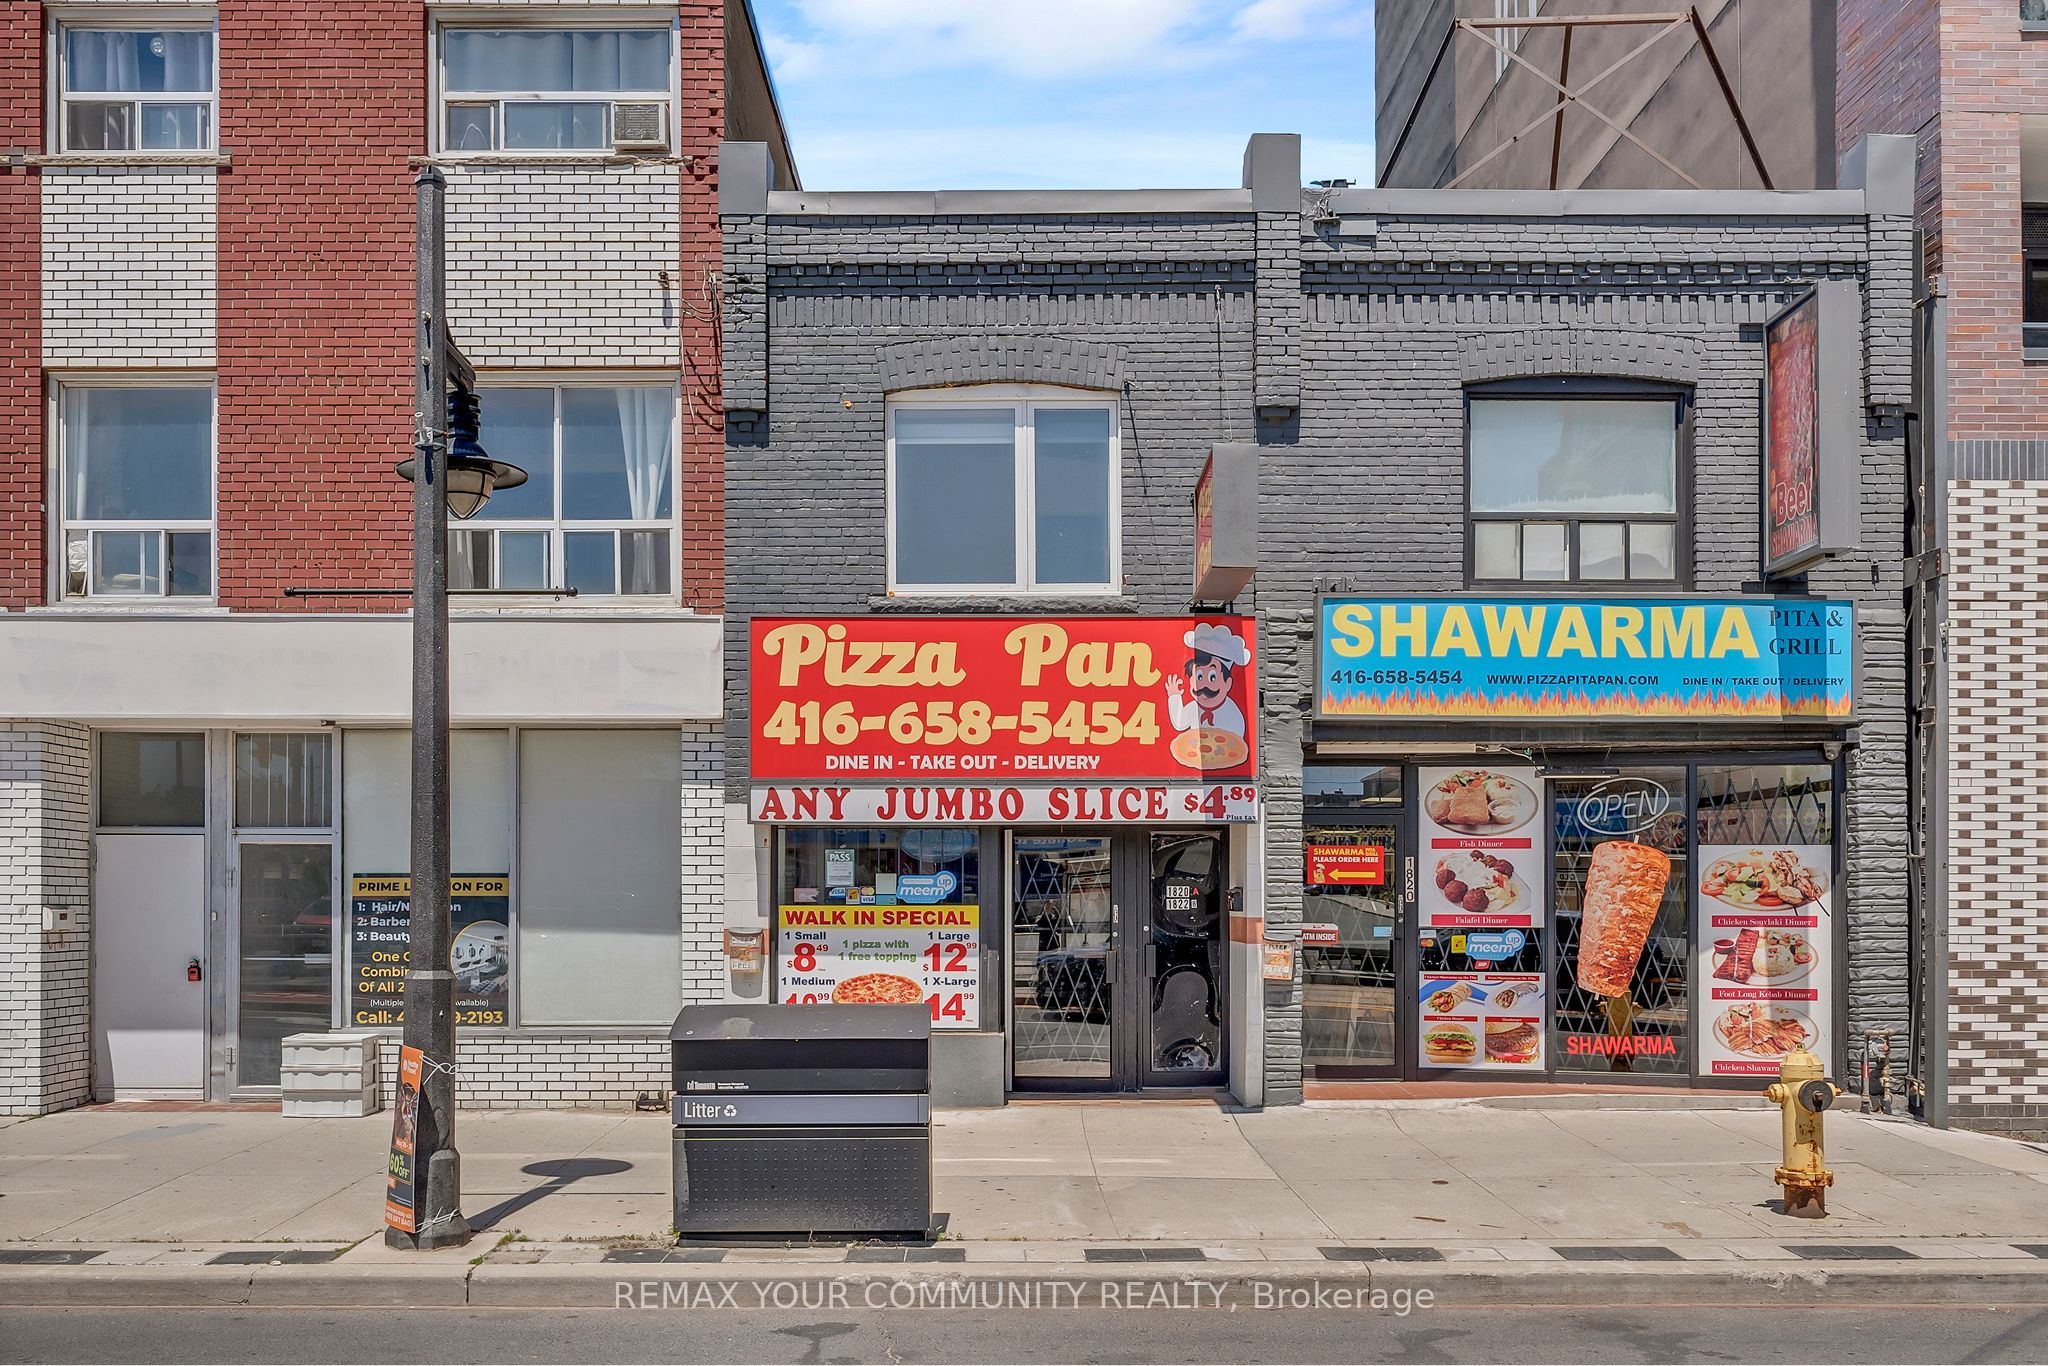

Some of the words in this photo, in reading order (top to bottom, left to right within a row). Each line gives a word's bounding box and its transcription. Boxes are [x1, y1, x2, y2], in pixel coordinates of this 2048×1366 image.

[1776, 466, 1812, 526] Beef
[1772, 513, 1818, 559] SHAWARMA
[1769, 610, 1820, 627] PITA
[1827, 610, 1843, 627] &
[1331, 604, 1760, 659] SHAWARMA
[1769, 638, 1842, 655] GRILL
[763, 624, 966, 687] Pizza
[1004, 624, 1161, 687] Pan
[1331, 670, 1462, 684] 416-658-5454
[1487, 675, 1659, 685] WWW.PIZZAPITAPAN.COM
[1683, 677, 1708, 685] DINE
[1712, 677, 1723, 685] IN
[1732, 677, 1759, 685] TAKE
[1762, 677, 1784, 685] OUT
[1793, 677, 1844, 686] DELIVERY
[763, 701, 1161, 745] 416-658-5454
[826, 755, 869, 770] DINE
[874, 755, 893, 770] IN
[910, 755, 956, 770] TAKE
[960, 755, 997, 770] OUT
[1014, 755, 1101, 770] DELIVERY
[759, 787, 851, 820] ANY
[877, 787, 1024, 820] JUMBO
[1048, 787, 1169, 820] SLICE
[1584, 788, 1660, 822] OPEN
[359, 882, 400, 892] PRIME
[476, 882, 503, 892] FOR
[900, 886, 945, 896] meem
[1168, 887, 1188, 896] 1820
[1168, 900, 1188, 909] 1822
[785, 911, 847, 925] WALK
[854, 911, 875, 925] IN
[882, 911, 971, 925] SPECIAL
[1717, 918, 1748, 926] Chicken
[1750, 918, 1783, 926] Souvlaki
[357, 932, 367, 941] 3:
[785, 932, 790, 940] 1
[795, 931, 827, 940] Small
[928, 932, 933, 940] 1
[938, 932, 970, 942] Large
[1316, 933, 1336, 941] INSIDE
[843, 940, 848, 948] 1
[852, 940, 881, 950] pizza
[885, 940, 909, 948] with
[1468, 943, 1513, 952] meem
[372, 951, 400, 962] One
[838, 953, 844, 961] 1
[848, 952, 871, 961] free
[874, 952, 917, 963] topping
[781, 977, 787, 985] 1
[791, 977, 836, 985] Medium
[923, 977, 928, 985] 1
[932, 977, 977, 987] X-Large
[359, 982, 375, 992] Of
[377, 982, 395, 992] All
[1738, 991, 1757, 999] Long
[455, 999, 489, 1007] vailable)
[356, 1011, 392, 1024] Call:
[1566, 1036, 1676, 1055] SHAWARMA
[684, 1101, 721, 1118] Litter
[398, 1166, 410, 1180] OFF
